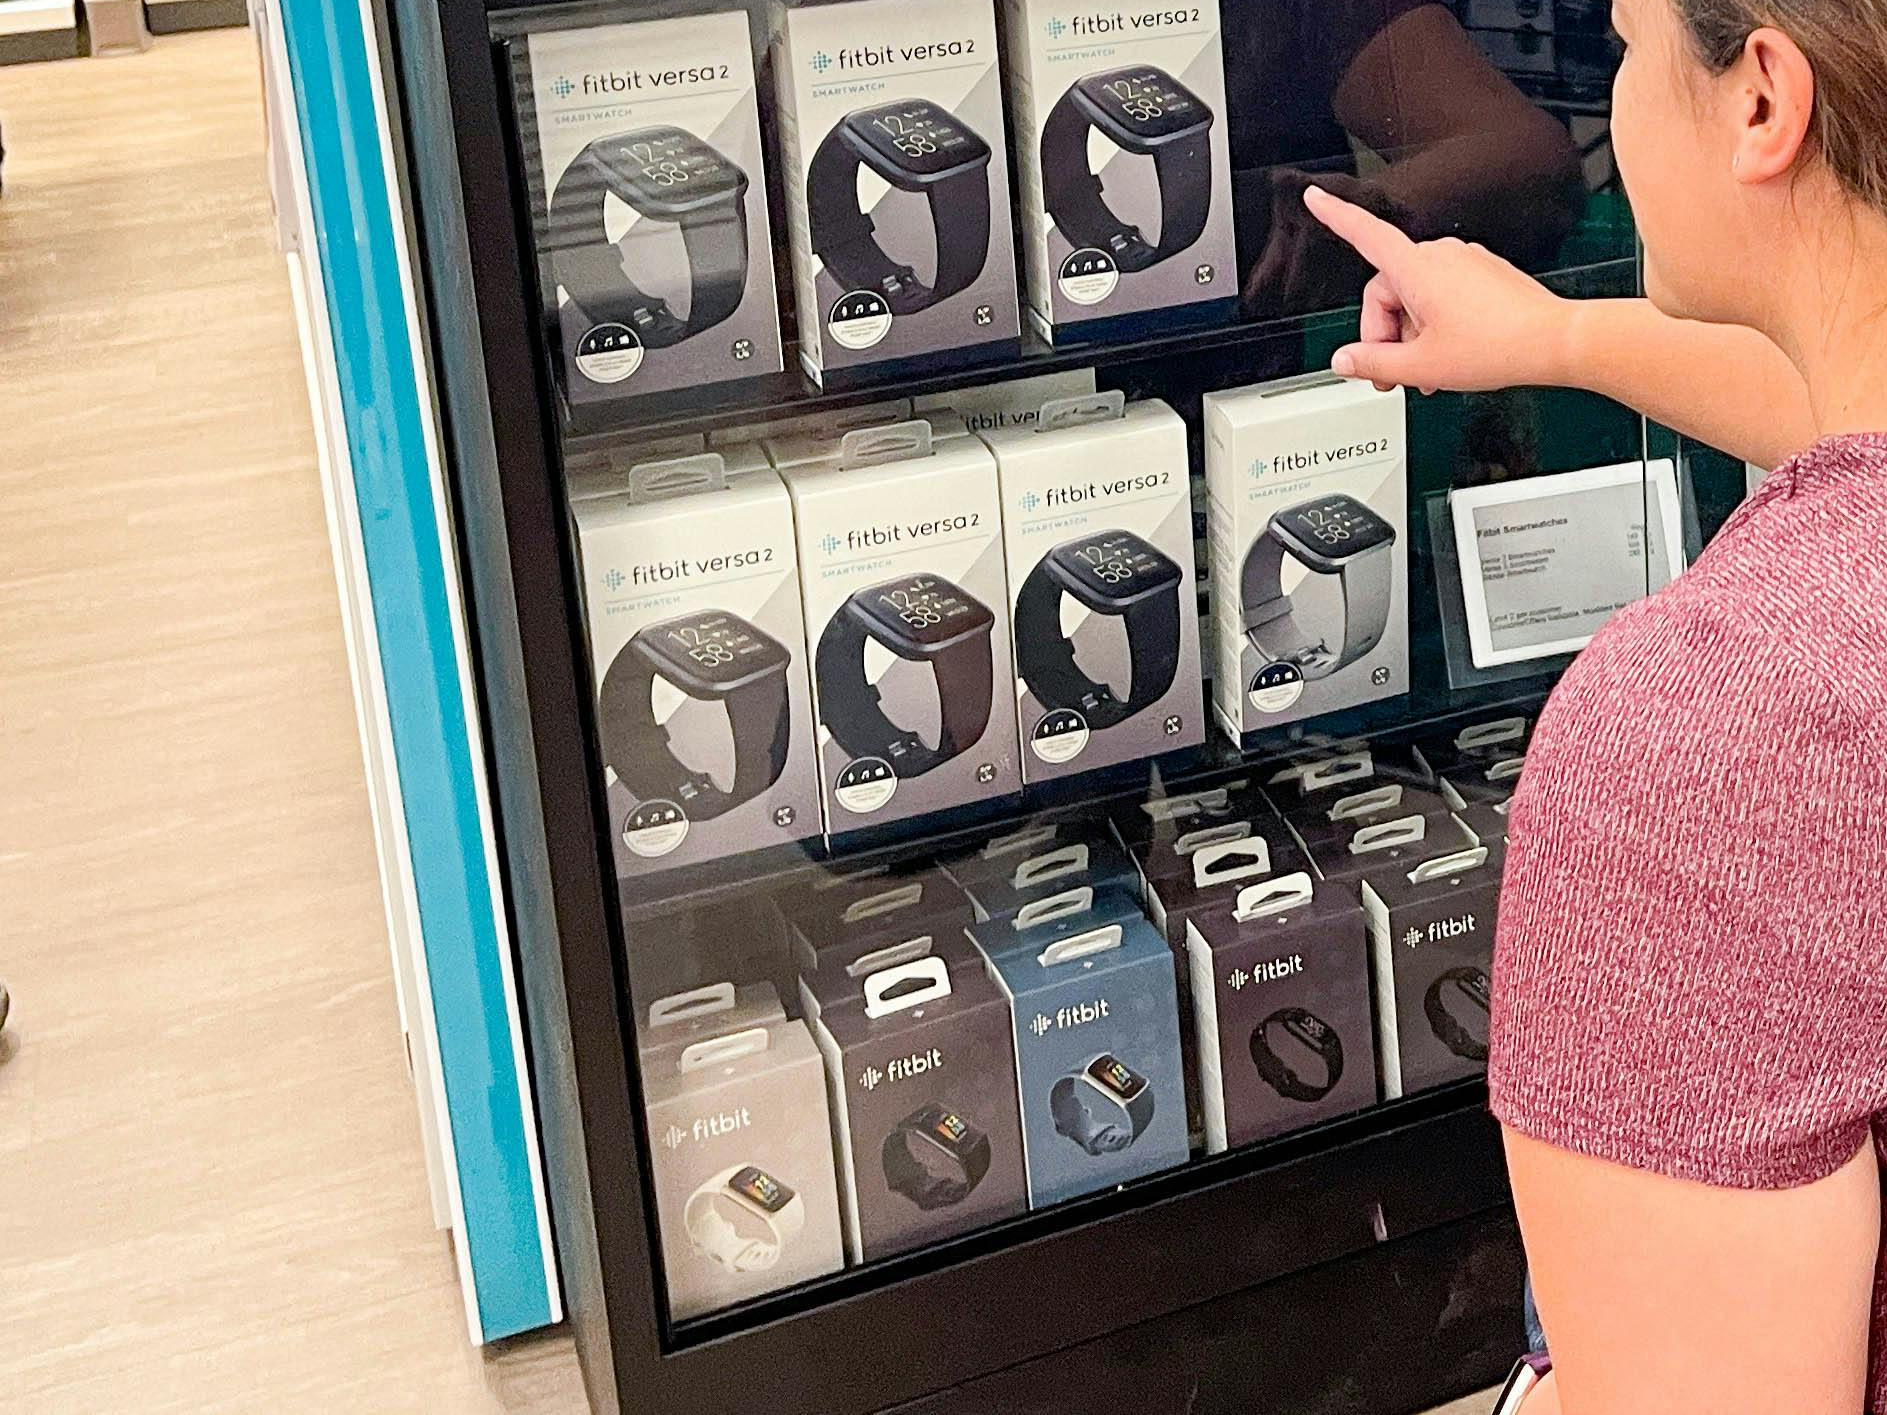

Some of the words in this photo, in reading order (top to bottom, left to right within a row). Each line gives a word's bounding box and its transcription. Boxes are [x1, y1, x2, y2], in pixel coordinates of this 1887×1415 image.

[1072, 12, 1125, 36] fitbit
[1130, 9, 1188, 28] versa
[1191, 8, 1200, 22] 2
[839, 45, 895, 70] fitbit
[900, 39, 963, 62] versa
[966, 39, 975, 54] 2
[1047, 48, 1116, 63] SMARTWATCH
[583, 69, 643, 96] fitbit
[649, 66, 716, 89] versa
[719, 64, 729, 79] 2
[812, 81, 886, 99] SMARTWATCH
[1102, 79, 1143, 101] 12
[554, 108, 633, 125] SMARTWATCH
[1122, 97, 1163, 122] 58
[872, 115, 914, 138] 12
[619, 142, 665, 166] 12
[892, 135, 937, 158] 58
[642, 161, 689, 187] 58
[1273, 450, 1320, 474] fitbit
[1324, 441, 1378, 463] versa
[1380, 438, 1389, 451] 2
[1046, 482, 1097, 508] fitbit
[1102, 474, 1158, 496] versa
[1161, 471, 1170, 485] 2
[1249, 481, 1312, 501] SMARTWATCH
[1021, 516, 1089, 535] SMARTWATCH
[1297, 509, 1334, 528] 12
[847, 524, 902, 551] fitbit
[907, 515, 968, 538] versa
[971, 512, 980, 527] 2
[1313, 523, 1351, 545] 58
[632, 559, 690, 586] fitbit
[696, 550, 760, 574] versa
[764, 547, 774, 562] 2
[1074, 546, 1115, 567] 12
[821, 560, 893, 579] SMARTWATCH
[1093, 561, 1133, 584] 58
[605, 595, 682, 617] SMARTWATCH
[878, 590, 920, 610] 12
[899, 606, 942, 629] 58
[667, 627, 711, 648] 12
[688, 643, 734, 668] 58
[1428, 914, 1476, 943] fitbit
[1253, 954, 1304, 985] fitbit
[1056, 999, 1110, 1030] fitbit
[886, 1048, 943, 1083] fitbit
[692, 1106, 750, 1141] fitbit
